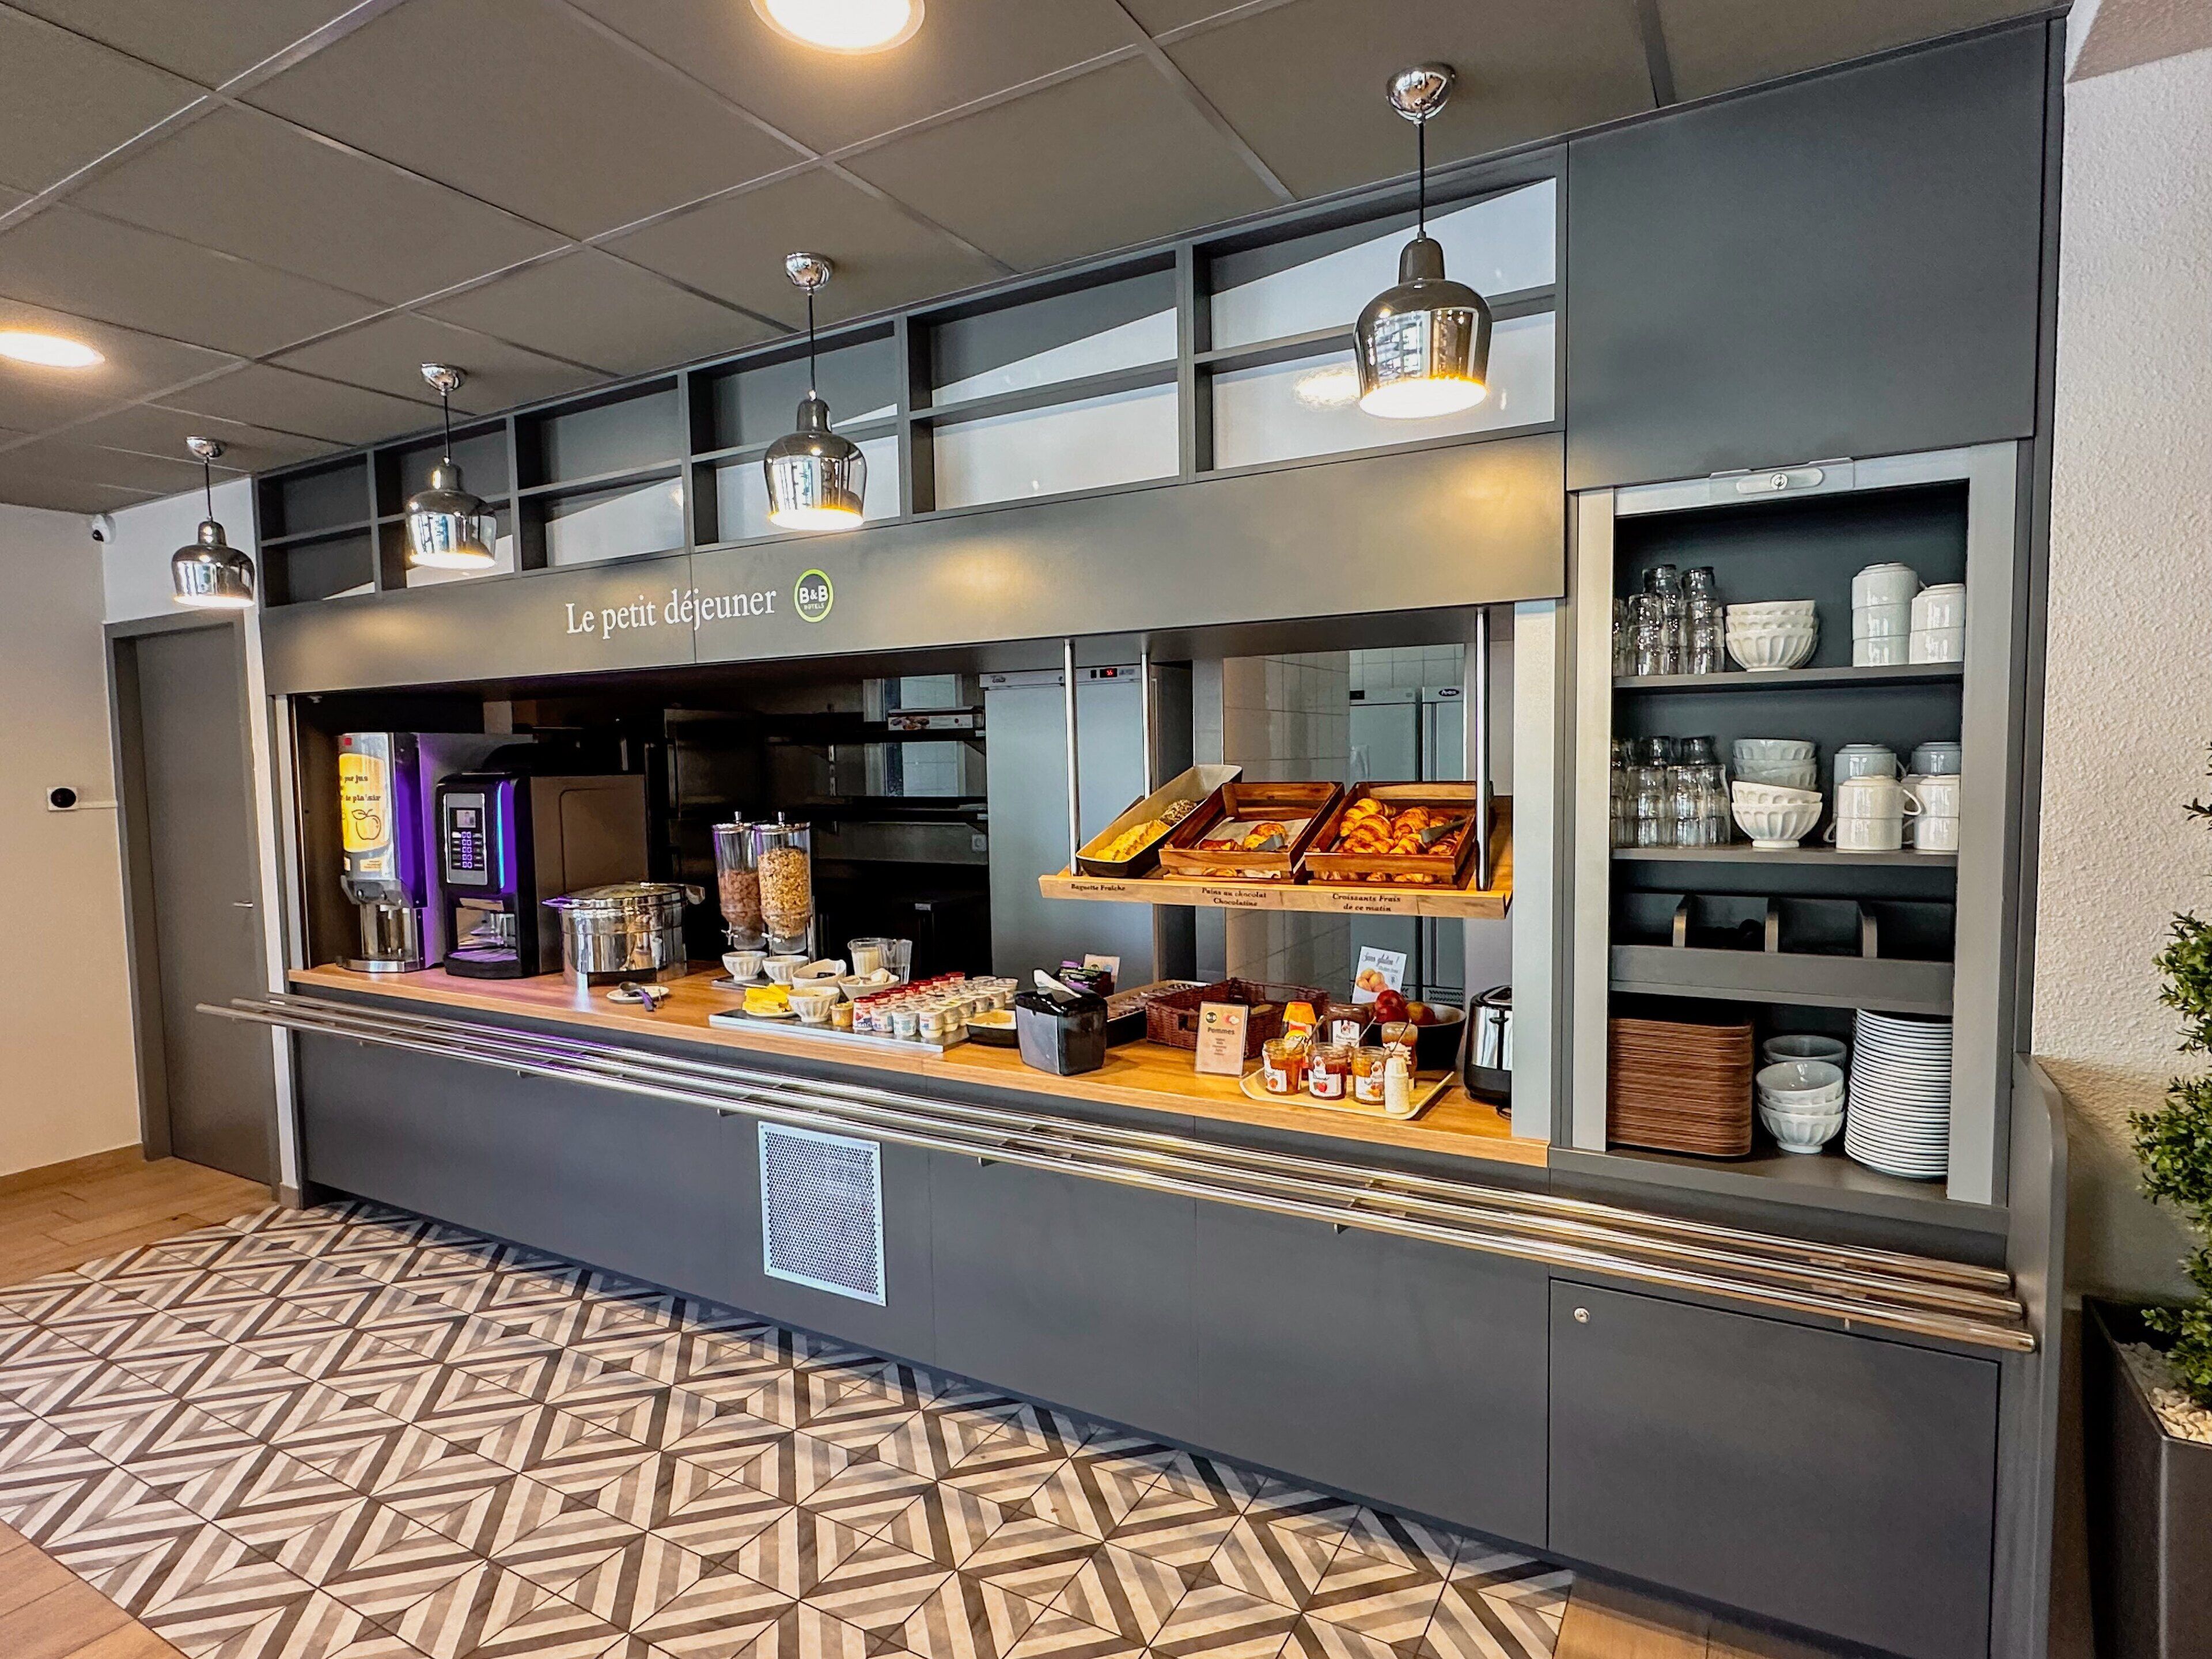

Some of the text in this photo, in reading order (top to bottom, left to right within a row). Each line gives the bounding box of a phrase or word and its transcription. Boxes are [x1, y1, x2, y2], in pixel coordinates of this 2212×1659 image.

[800, 585, 828, 604] B&B
[565, 588, 777, 639] Le petit déjeuner
[1213, 897, 1257, 906] Chocolatine
[1332, 893, 1377, 902] Croissants
